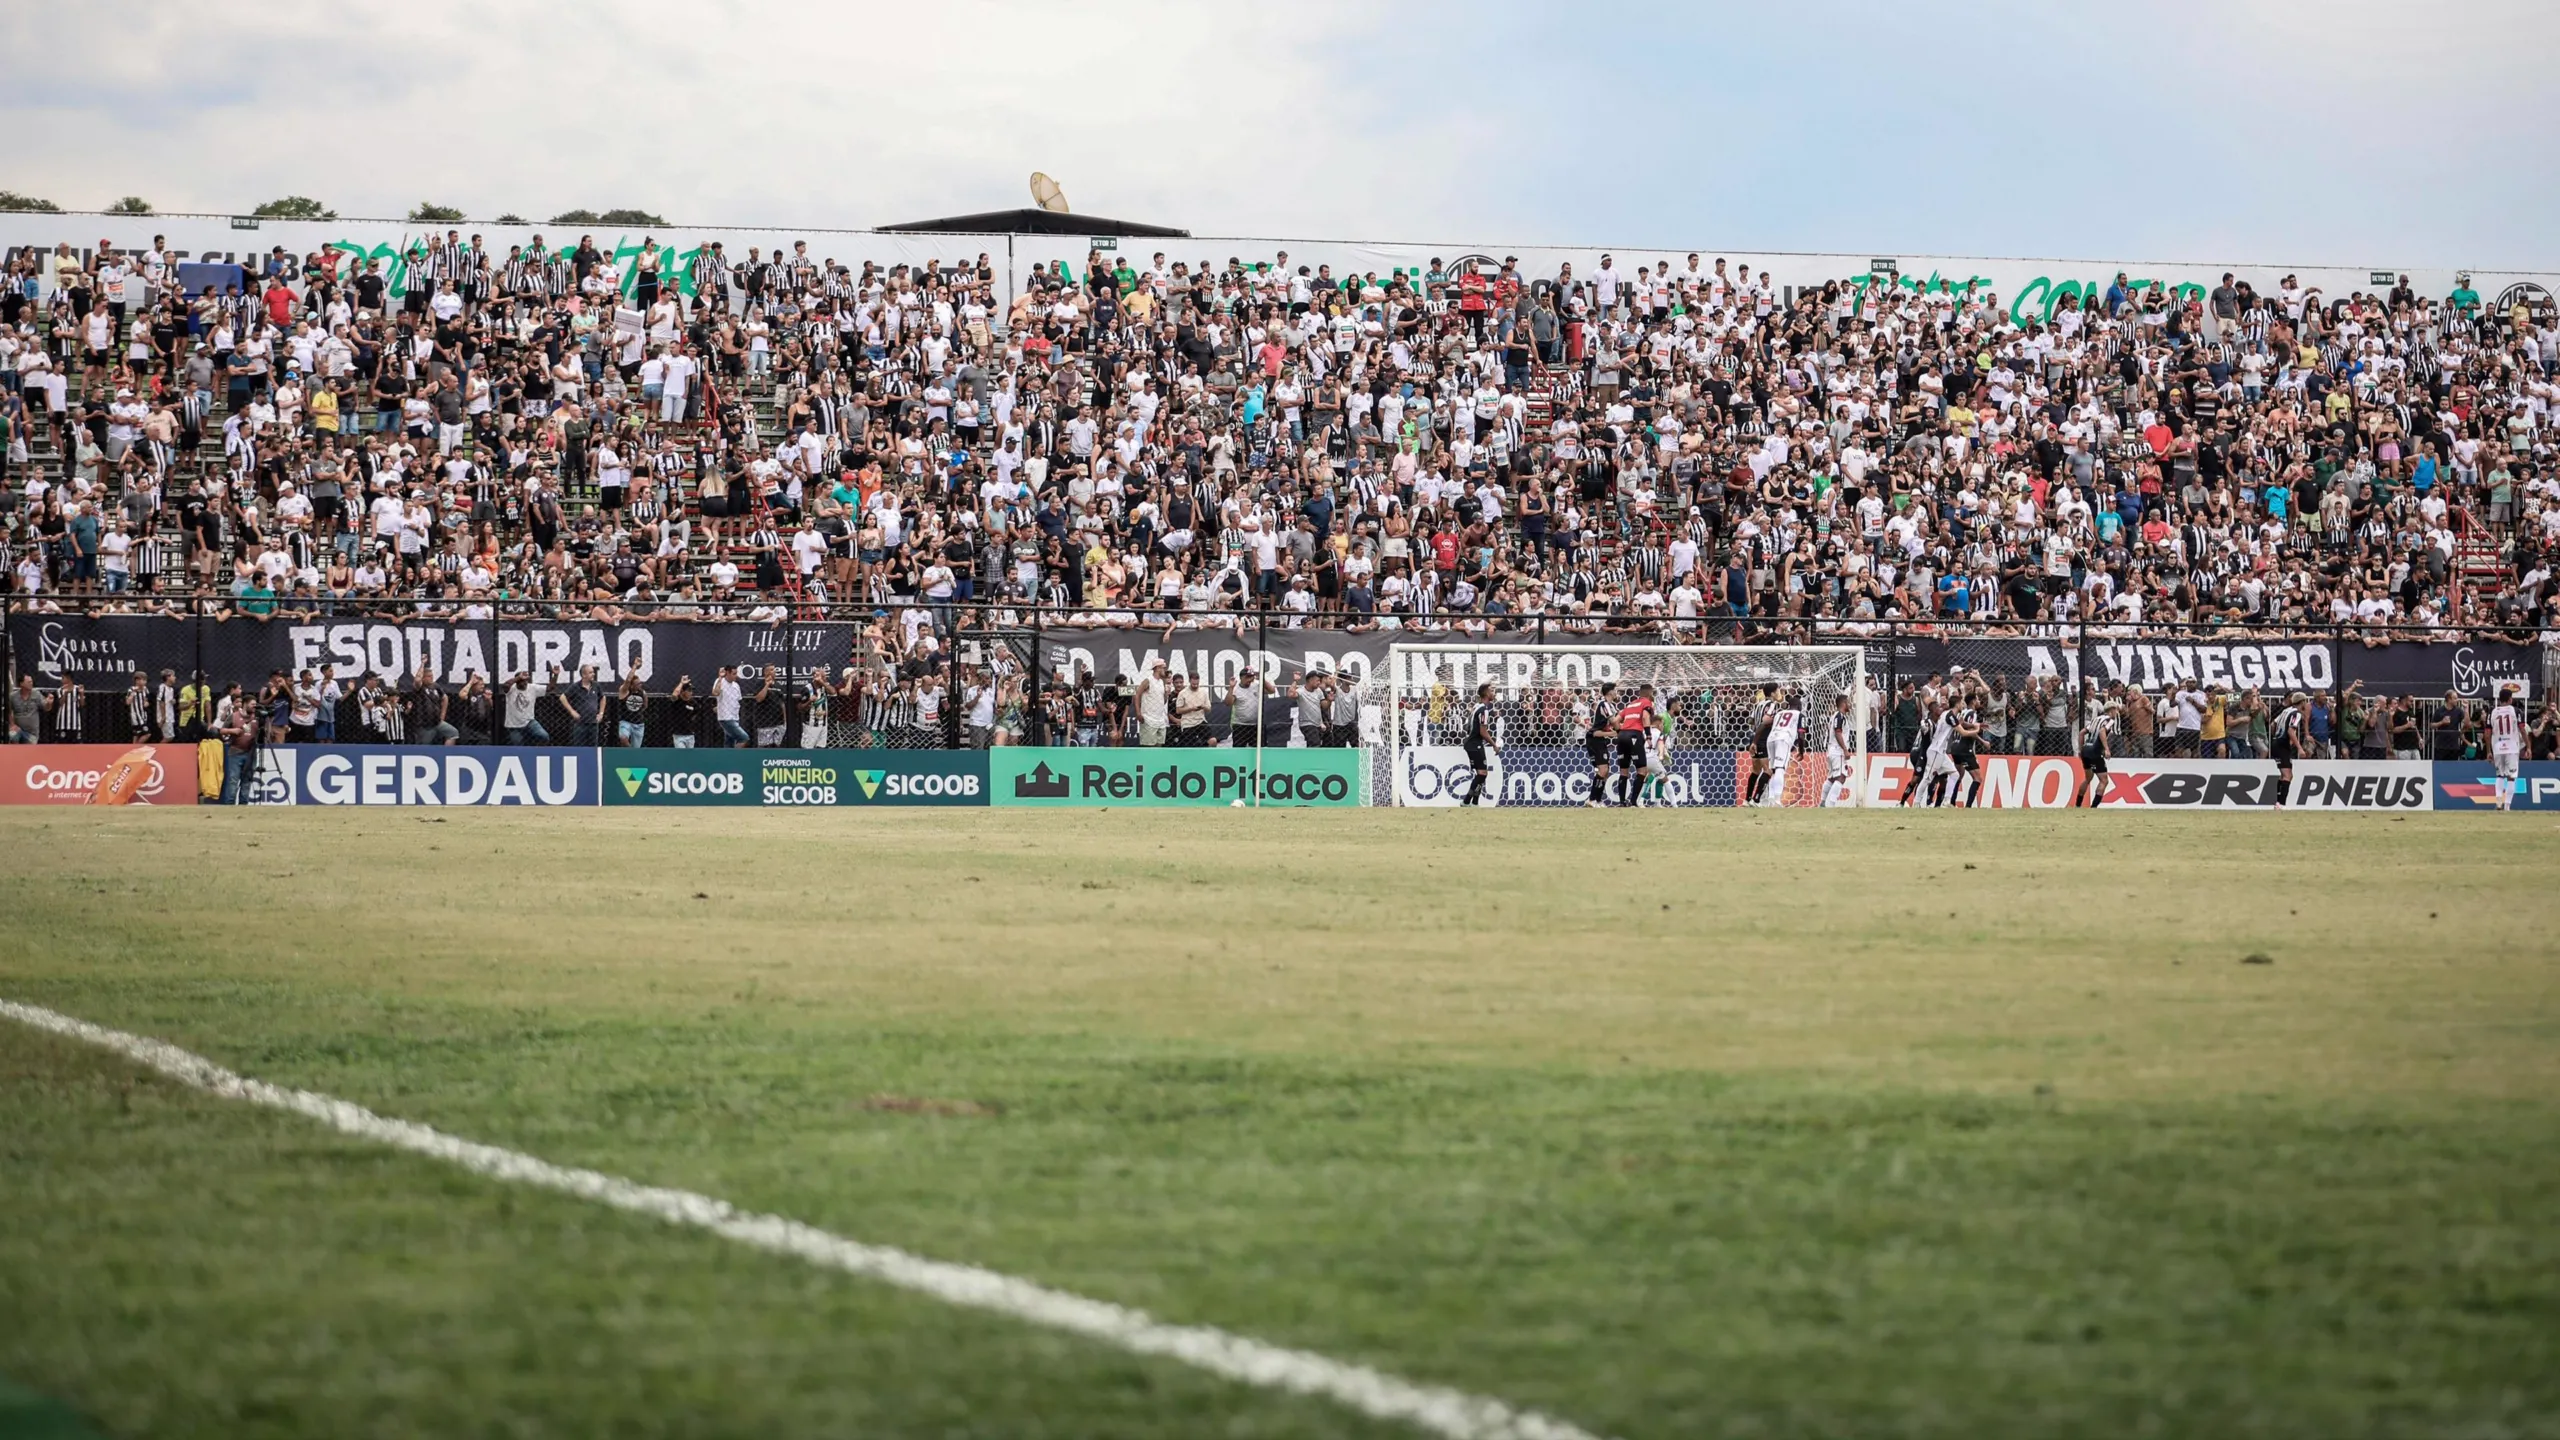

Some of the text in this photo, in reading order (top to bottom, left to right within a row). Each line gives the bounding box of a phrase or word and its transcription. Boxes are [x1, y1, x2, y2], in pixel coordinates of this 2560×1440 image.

[1092, 239, 1109, 247] SETOR
[1872, 262, 1888, 270] SETOR
[1118, 649, 1281, 701] MAIOR
[2027, 644, 2334, 690] ALVINEGRO
[1775, 712, 1793, 728] 19
[2496, 714, 2512, 735] 11
[762, 759, 811, 767] CAMPEONATO
[110, 764, 131, 794] SCHIN
[306, 754, 578, 805] GERDAU
[648, 772, 744, 794] SICOOB
[762, 767, 837, 784] MINEIRO
[886, 774, 980, 796] SICOOB
[1082, 765, 1349, 801] Rei do Pitaco
[763, 785, 837, 805] SICOOB
[2296, 775, 2427, 807] PNEUS
